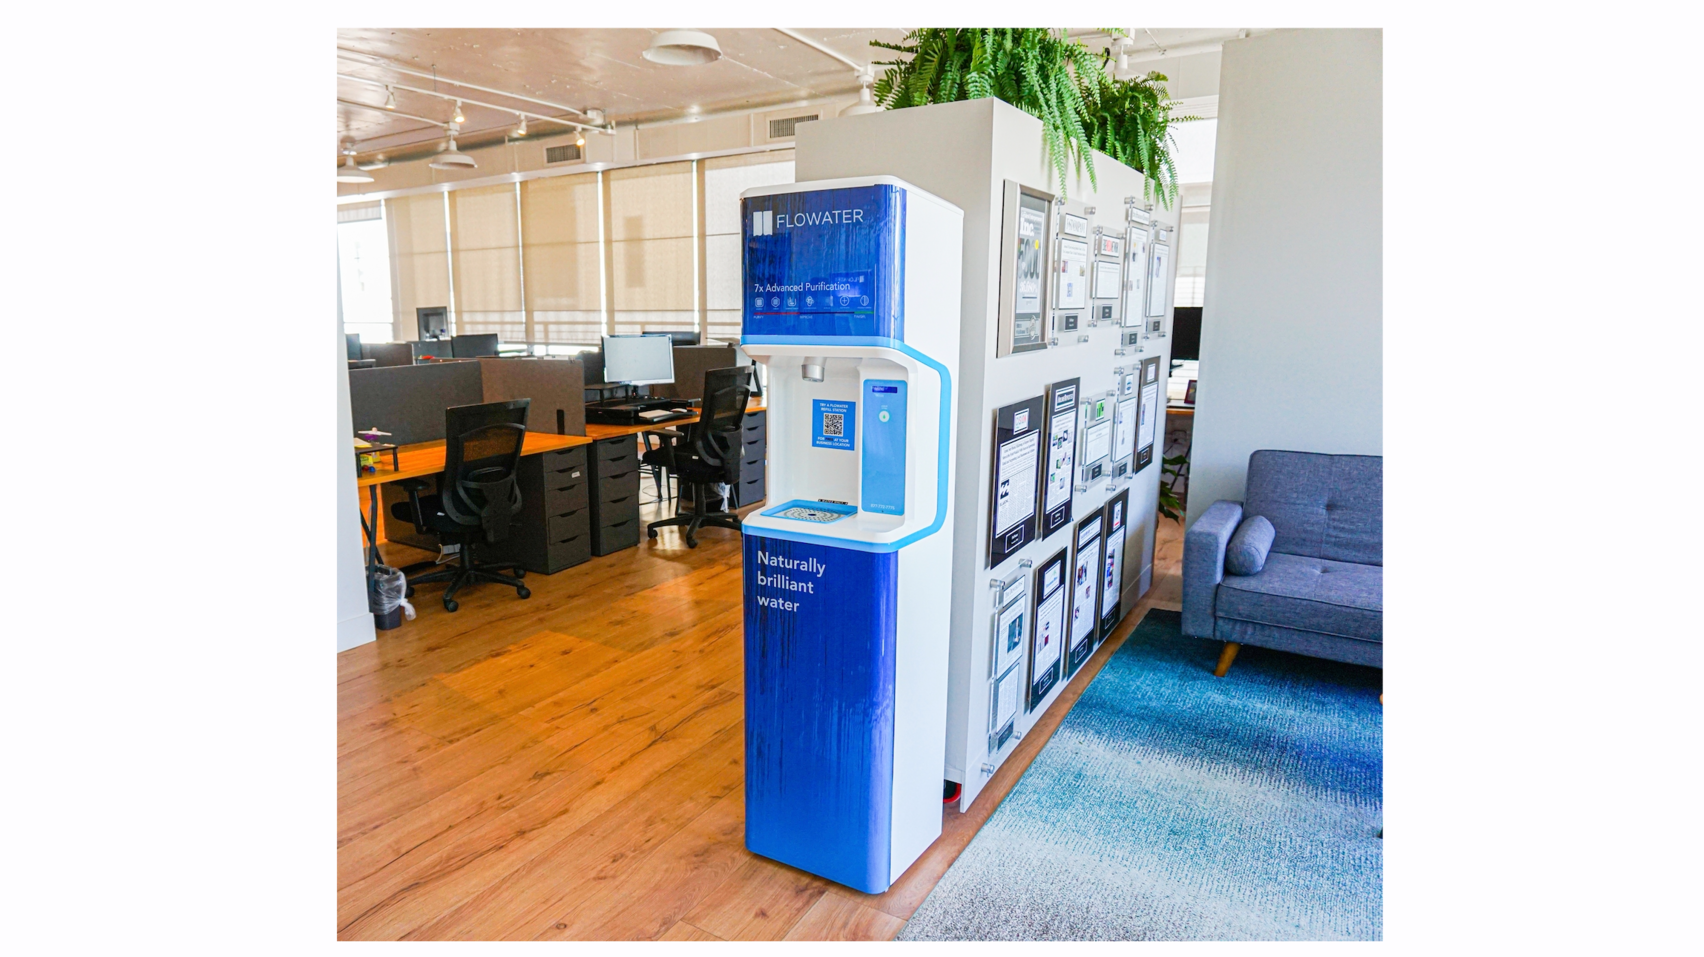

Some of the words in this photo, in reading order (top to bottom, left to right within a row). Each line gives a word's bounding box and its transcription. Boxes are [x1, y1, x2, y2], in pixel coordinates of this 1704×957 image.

[776, 209, 864, 229] FLOWATER
[754, 284, 764, 292] 7x
[765, 282, 803, 292] Advanced
[805, 281, 851, 291] Purification
[757, 550, 826, 578] Naturally
[757, 571, 814, 594] brilliant
[757, 596, 800, 612] water
